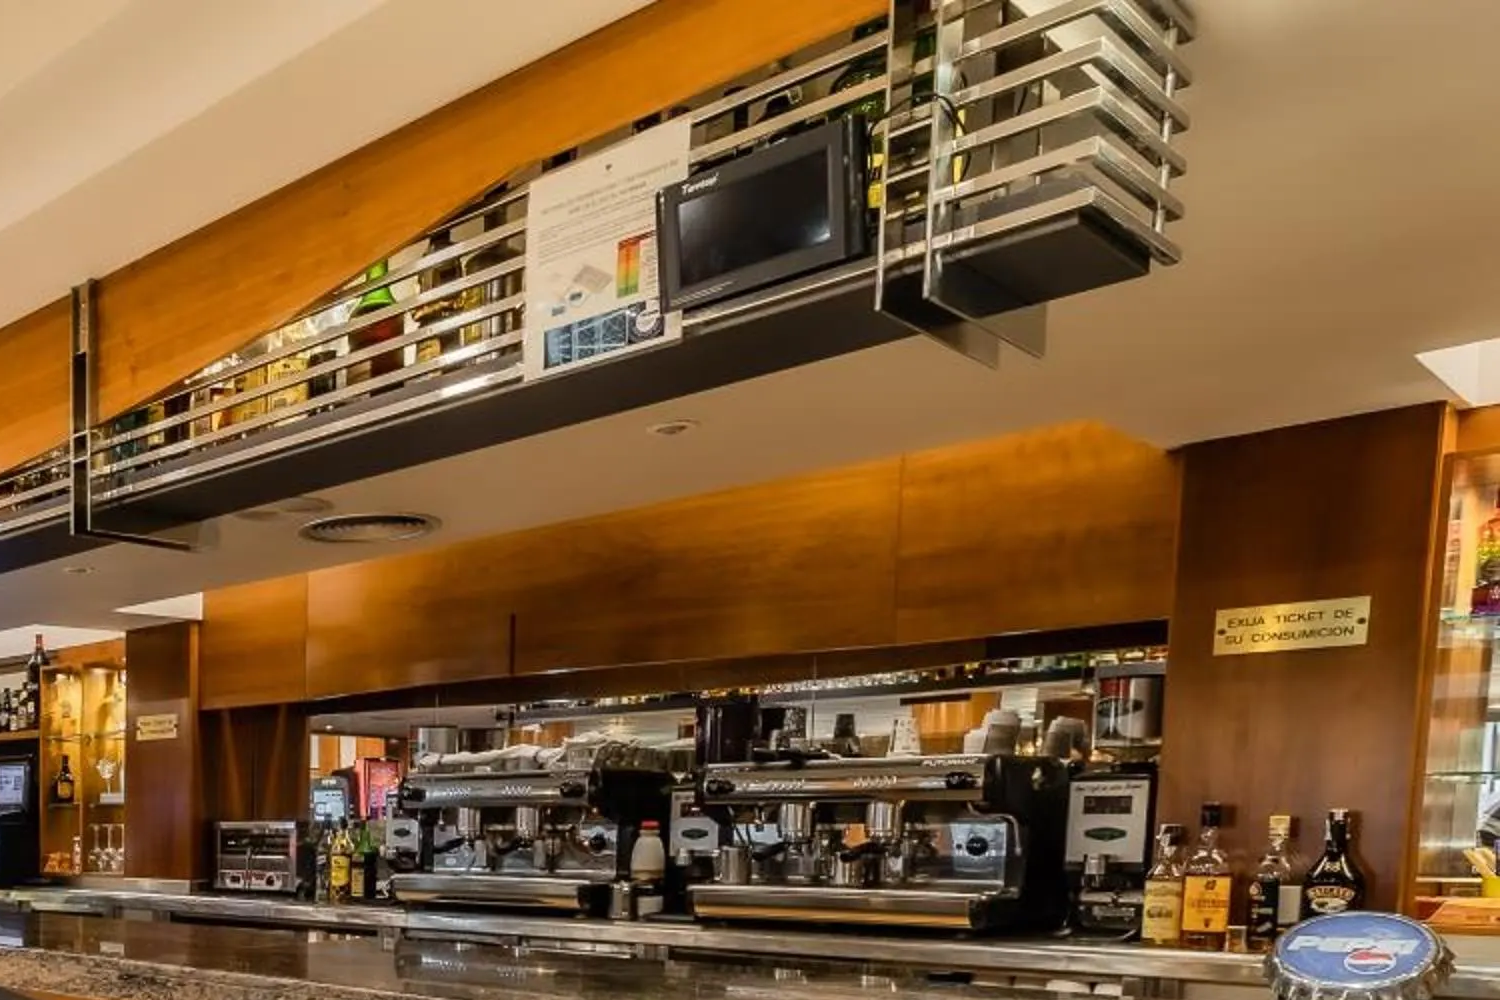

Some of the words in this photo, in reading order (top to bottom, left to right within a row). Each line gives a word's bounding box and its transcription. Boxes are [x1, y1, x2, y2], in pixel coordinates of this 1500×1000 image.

[1275, 611, 1324, 625] TICKET
[1333, 608, 1355, 620] DE
[1224, 635, 1243, 646] SU
